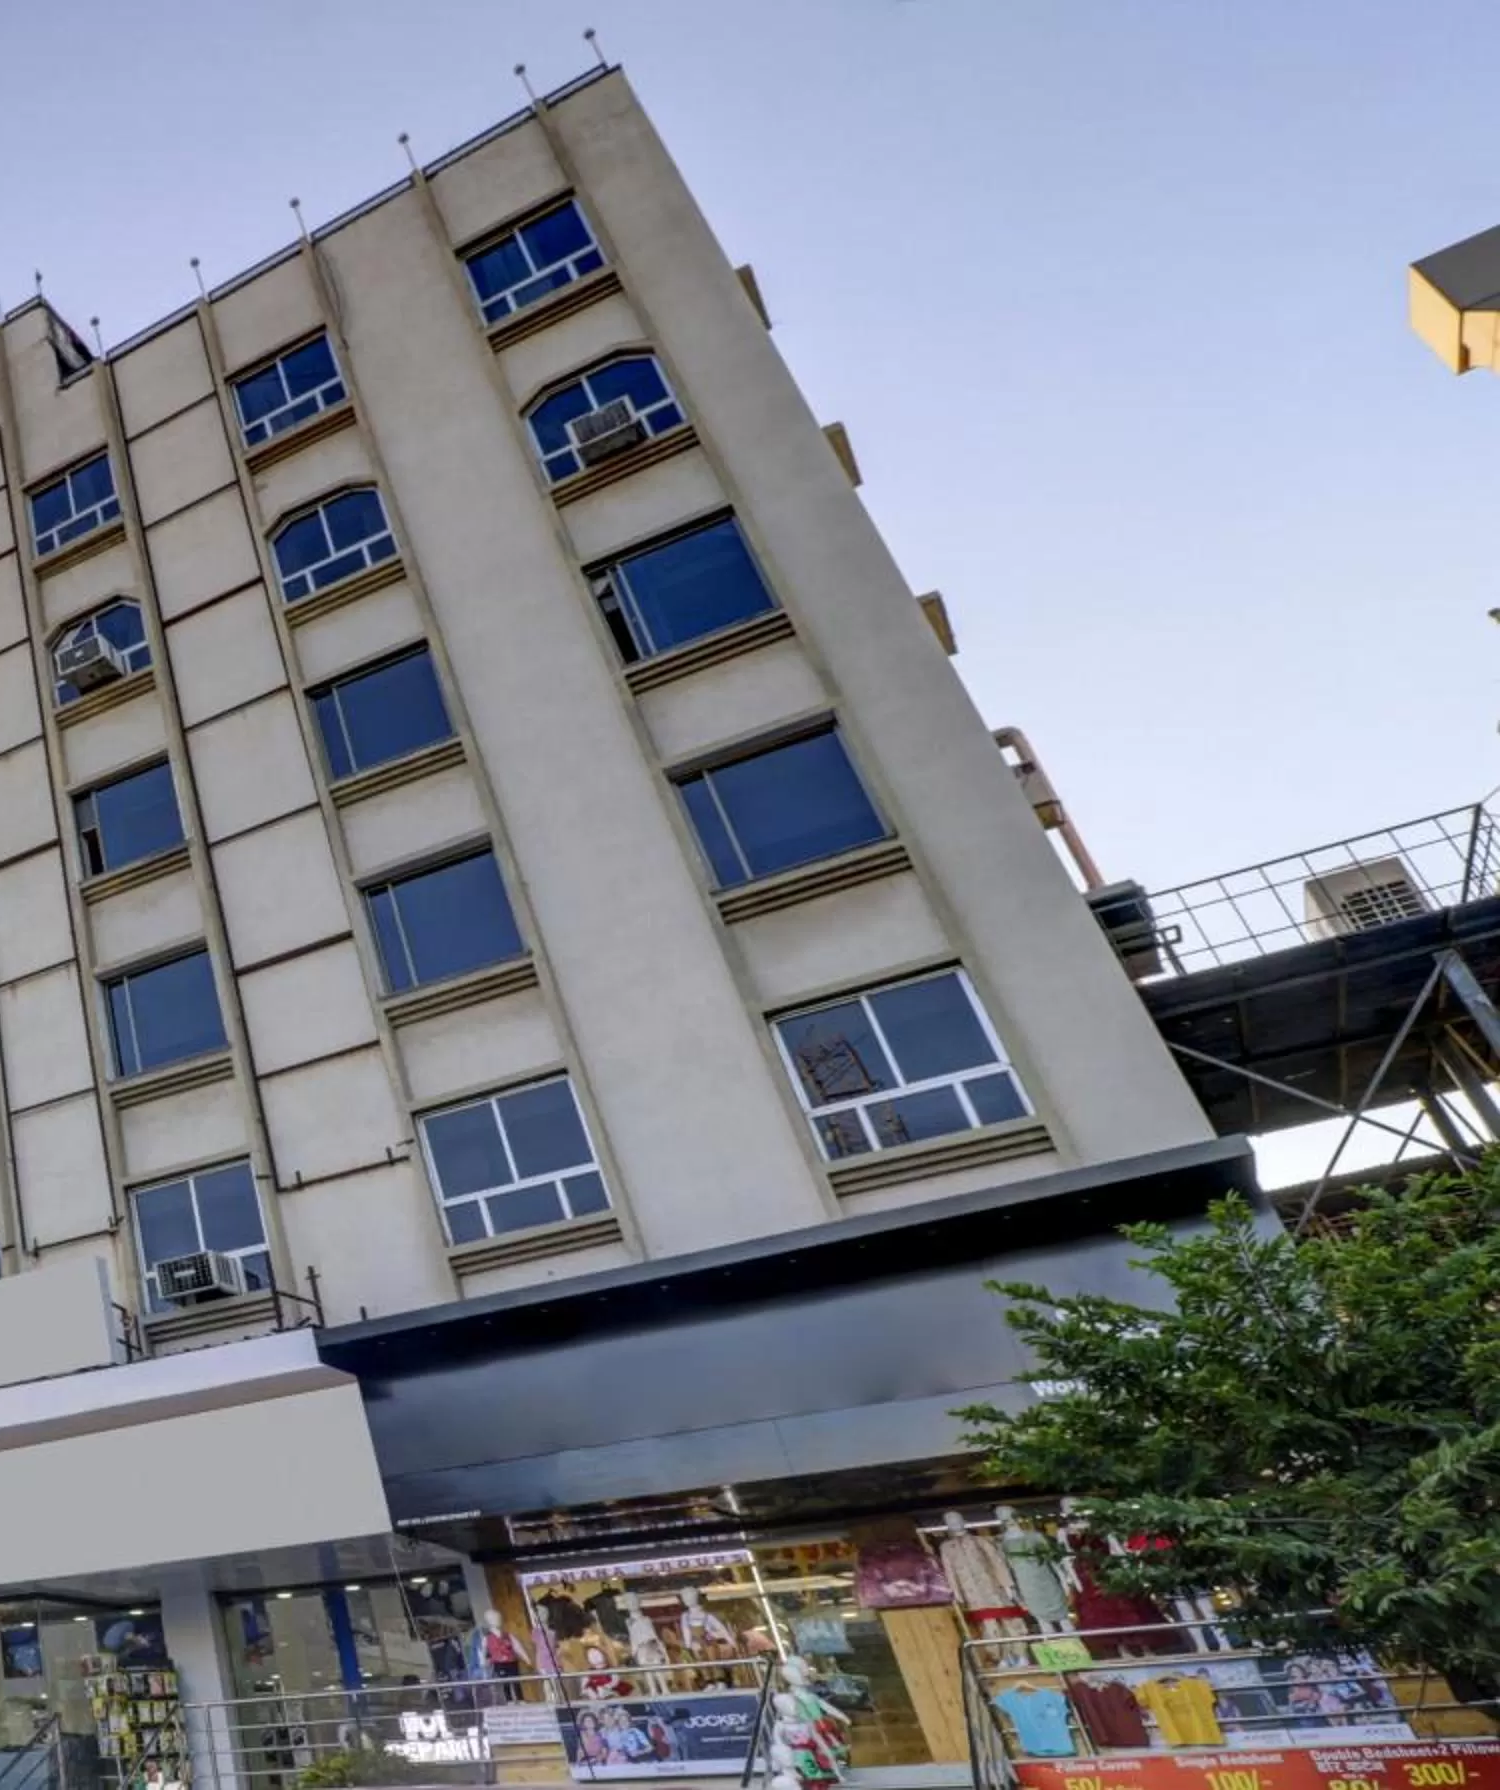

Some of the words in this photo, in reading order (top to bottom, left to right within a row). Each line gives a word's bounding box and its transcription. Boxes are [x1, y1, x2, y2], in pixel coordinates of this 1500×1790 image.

[683, 1713, 748, 1729] JOCKEY
[1204, 1768, 1274, 1790] 100/-
[1403, 1760, 1481, 1787] 300/-
